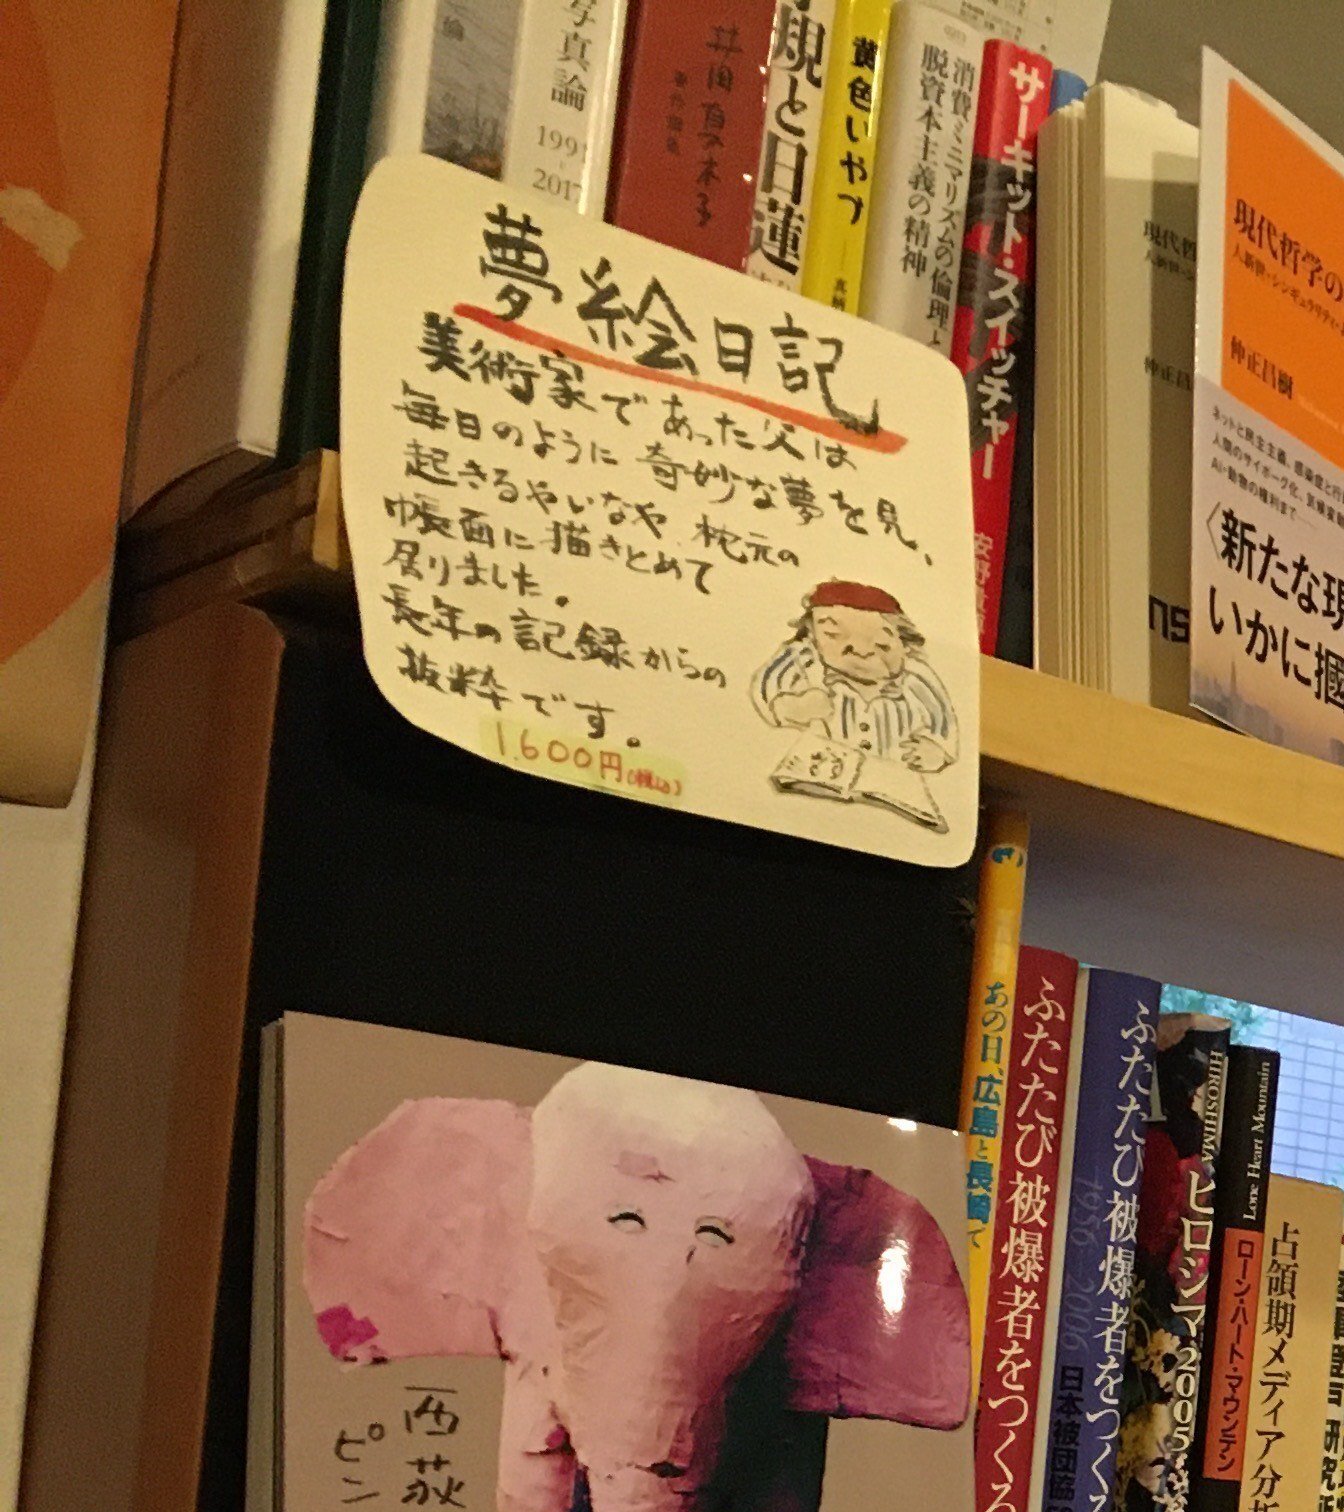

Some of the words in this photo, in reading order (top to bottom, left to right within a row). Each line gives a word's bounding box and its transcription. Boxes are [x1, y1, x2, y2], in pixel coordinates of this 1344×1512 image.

[899, 42, 950, 278] 脱資本主義の精神
[478, 205, 880, 436] 夢絵日記
[976, 61, 1045, 480] サーキット・スイッチャー
[418, 310, 858, 471] 美術家であった父は
[1229, 333, 1295, 403] 仲正昌樹
[385, 492, 712, 595] 帳面に描きとめて
[382, 585, 728, 690] 長年の記録からの
[397, 644, 642, 748] 抜粋です。
[966, 980, 1012, 1249] あの日、広島と長崎で
[1201, 1049, 1224, 1170] HIROSHIMA
[1253, 1060, 1272, 1130] Mountain
[1242, 1180, 1259, 1222] Lone
[1246, 1132, 1264, 1181] Heart
[1213, 1238, 1257, 1473] ローン・ハート・マウンテン
